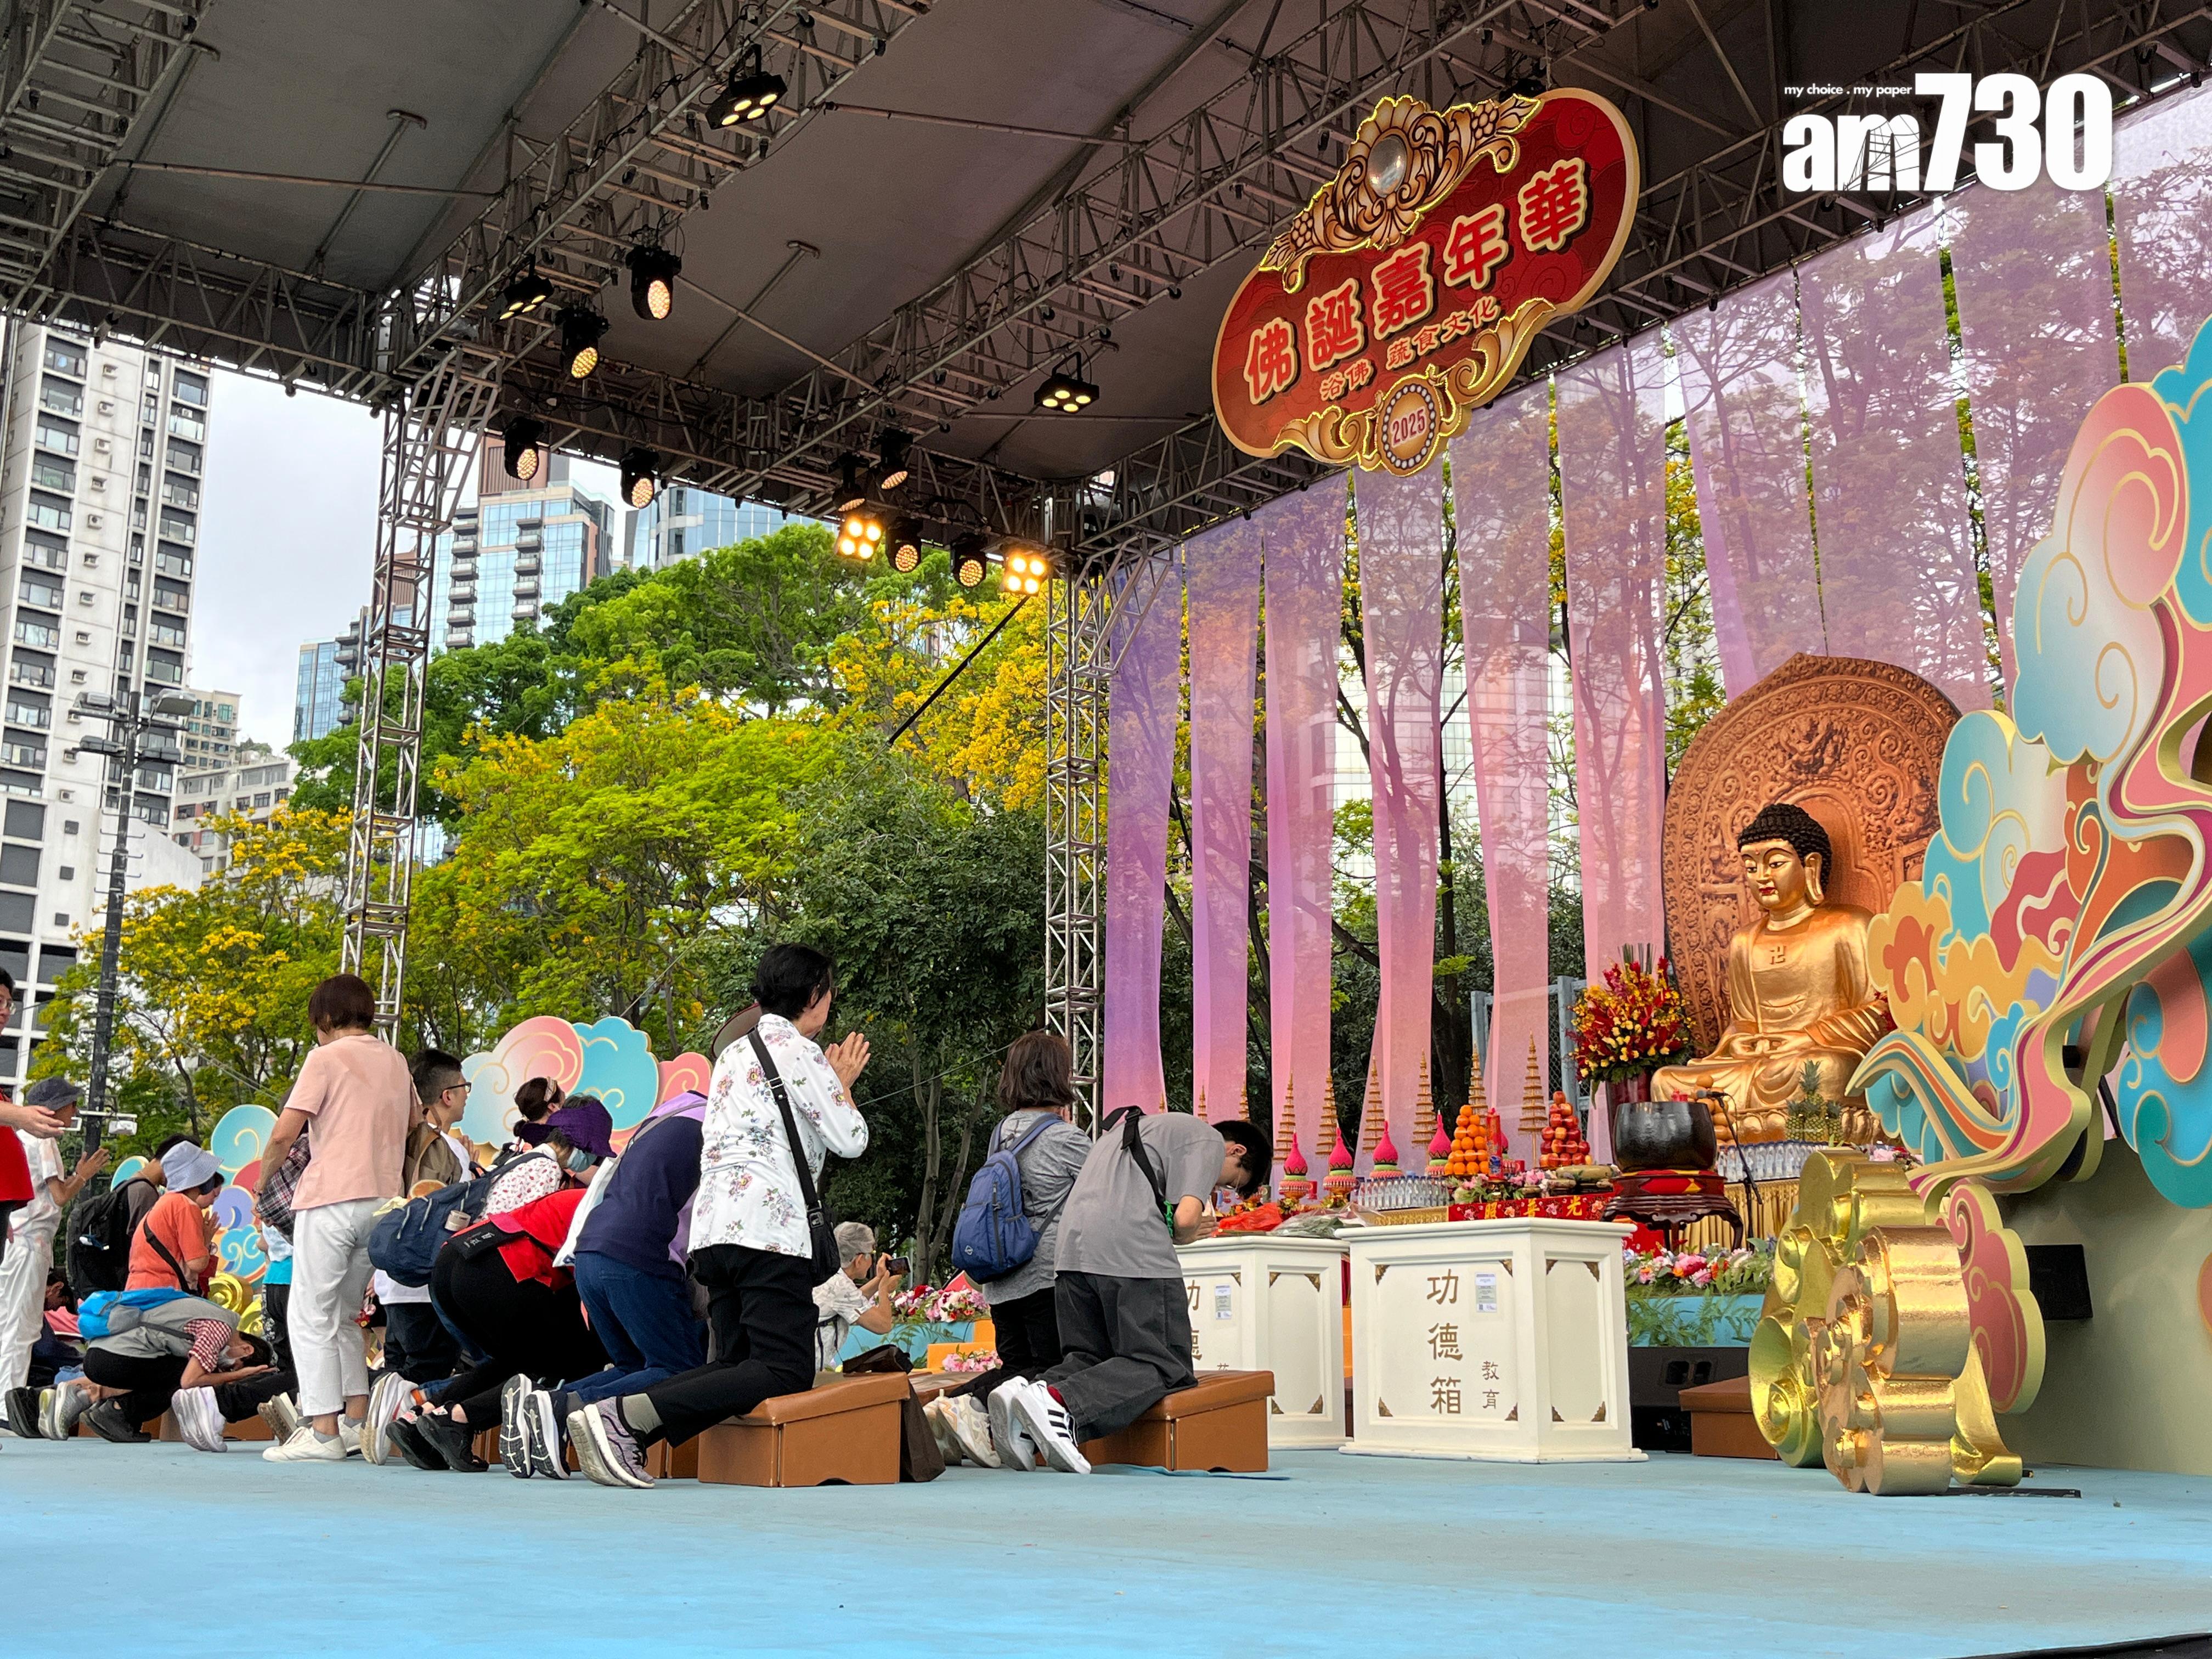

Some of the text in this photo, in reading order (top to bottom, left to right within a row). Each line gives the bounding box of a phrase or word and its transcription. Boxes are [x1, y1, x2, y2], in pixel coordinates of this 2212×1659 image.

[1245, 157, 1585, 403] 佛誕嘉年華
[1321, 296, 1500, 400] 浴佛 蔬食文化
[1392, 408, 1426, 445] 2025
[1426, 1268, 1463, 1414] 功德箱
[1481, 1360, 1500, 1409] 教育
